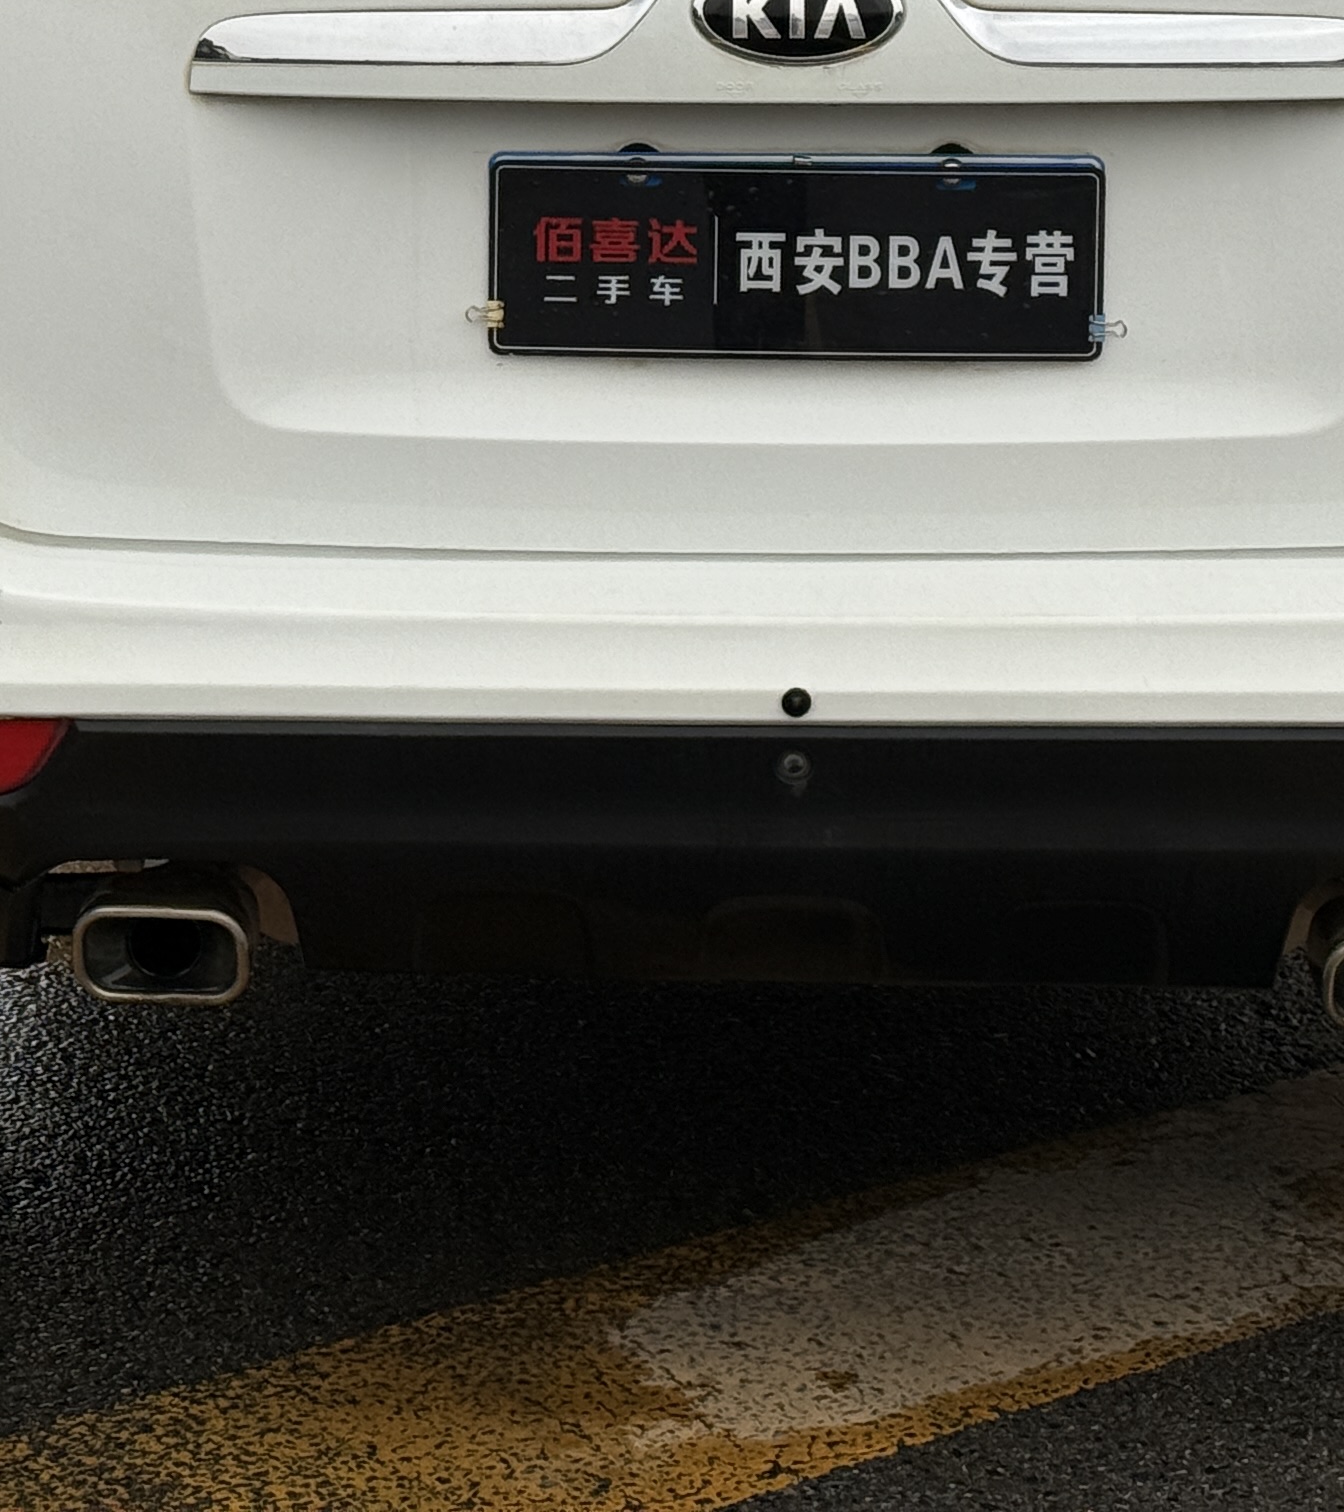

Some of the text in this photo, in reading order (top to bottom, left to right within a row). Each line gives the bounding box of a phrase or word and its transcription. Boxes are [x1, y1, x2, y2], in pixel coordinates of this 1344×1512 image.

[532, 216, 699, 266] 佰喜达
[734, 228, 1077, 298] 西安BBA专营
[543, 274, 685, 307] 二手车
